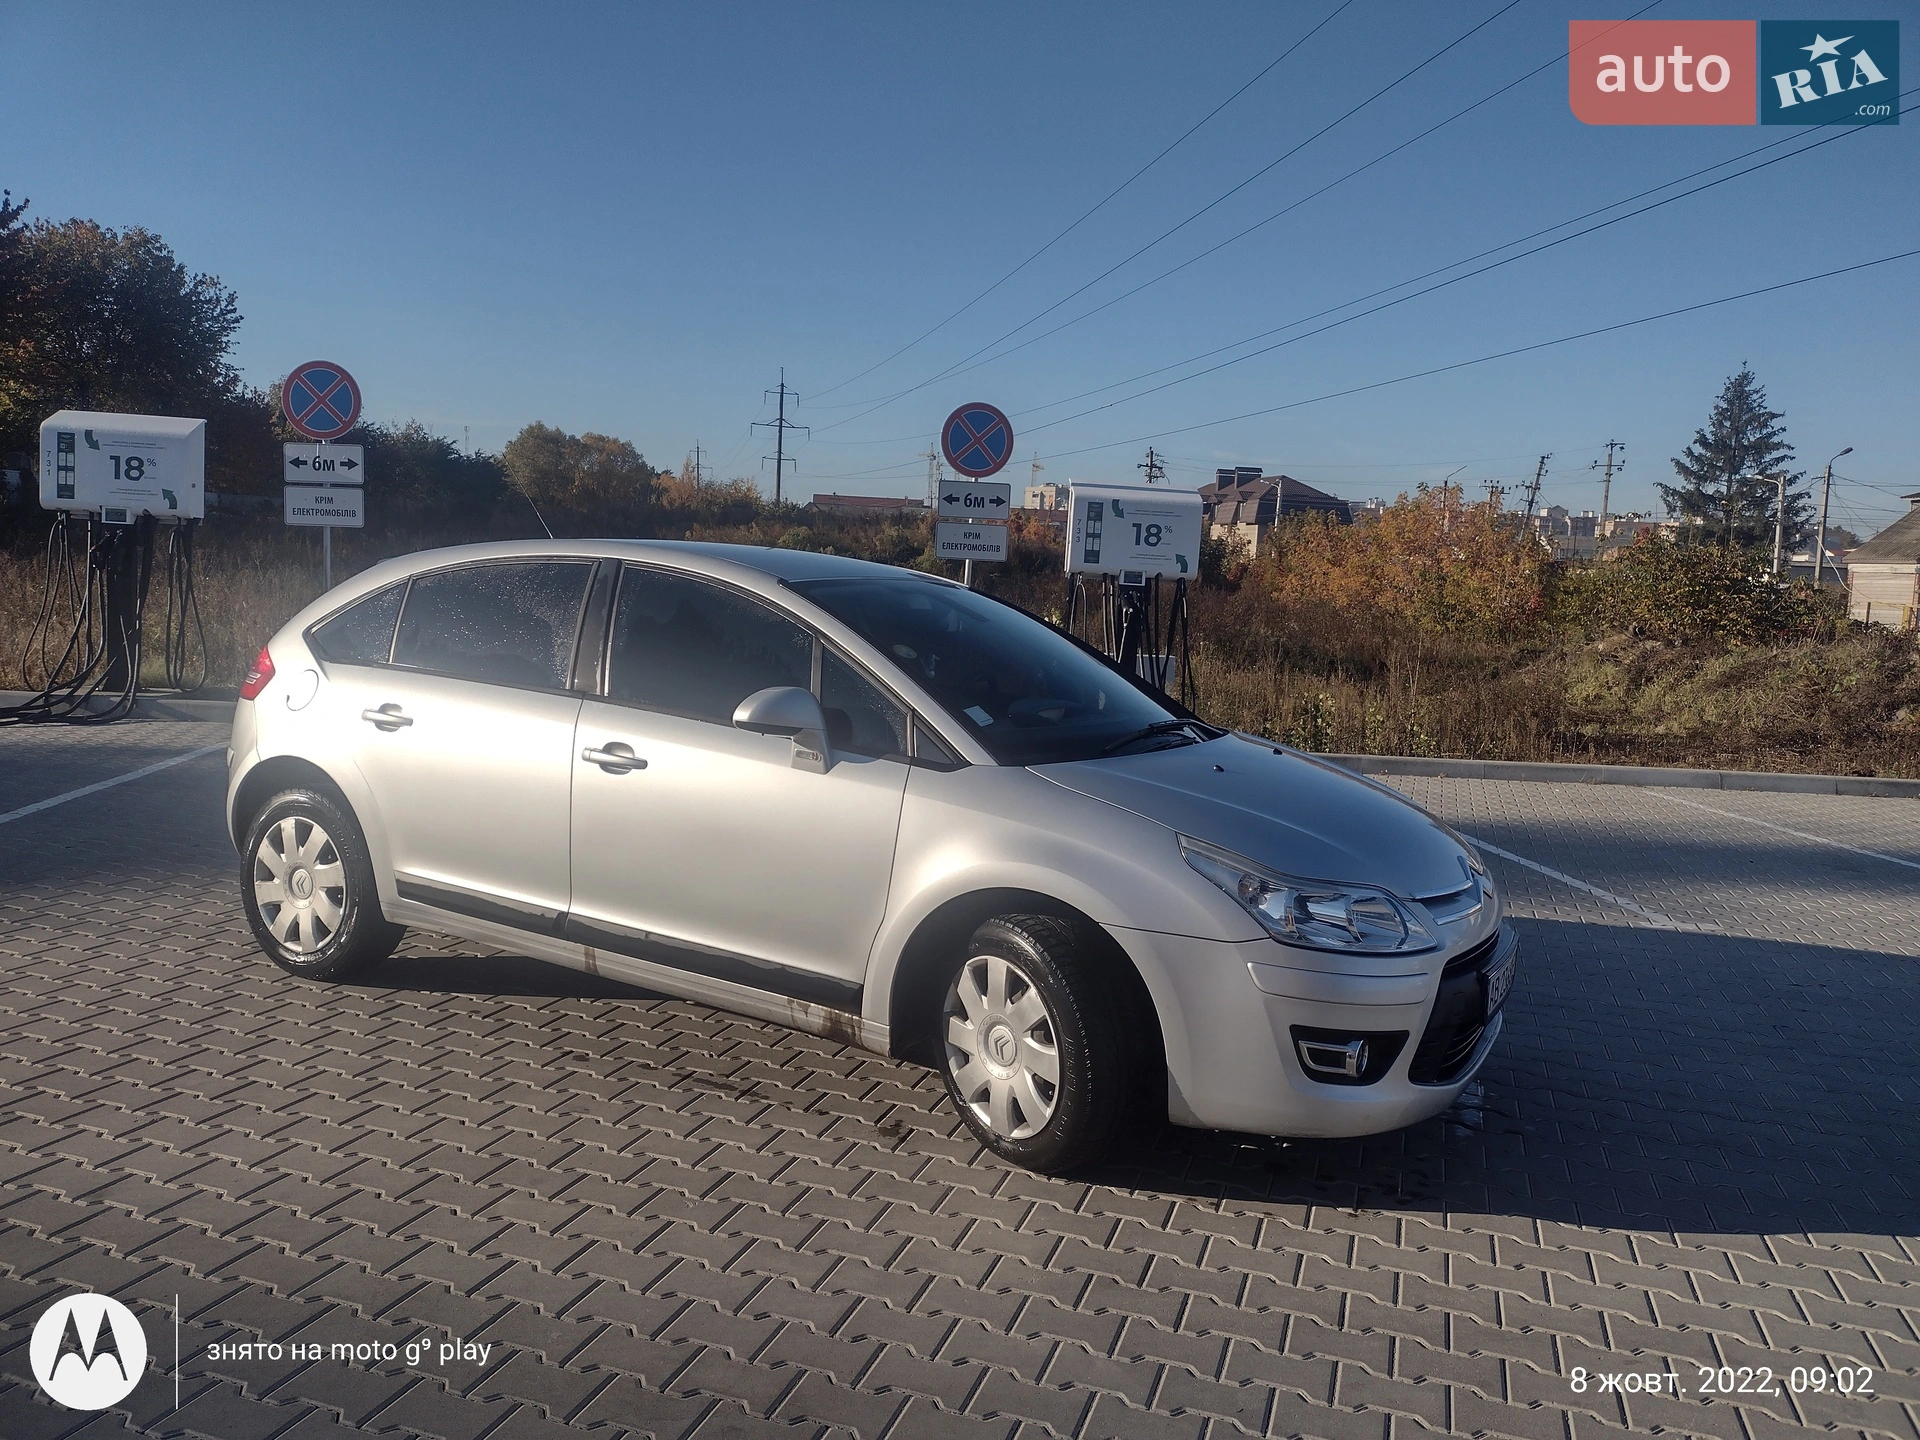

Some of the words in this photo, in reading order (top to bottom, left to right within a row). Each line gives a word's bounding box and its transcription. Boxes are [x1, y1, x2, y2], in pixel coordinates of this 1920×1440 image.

[314, 496, 334, 505] КРІМ
[292, 507, 357, 518] ЕЛЕКТРОМОБІЛІВ
[963, 531, 981, 540] КРІМ
[942, 541, 1001, 553] ЕЛЕКТРОМОБІЛІВ
